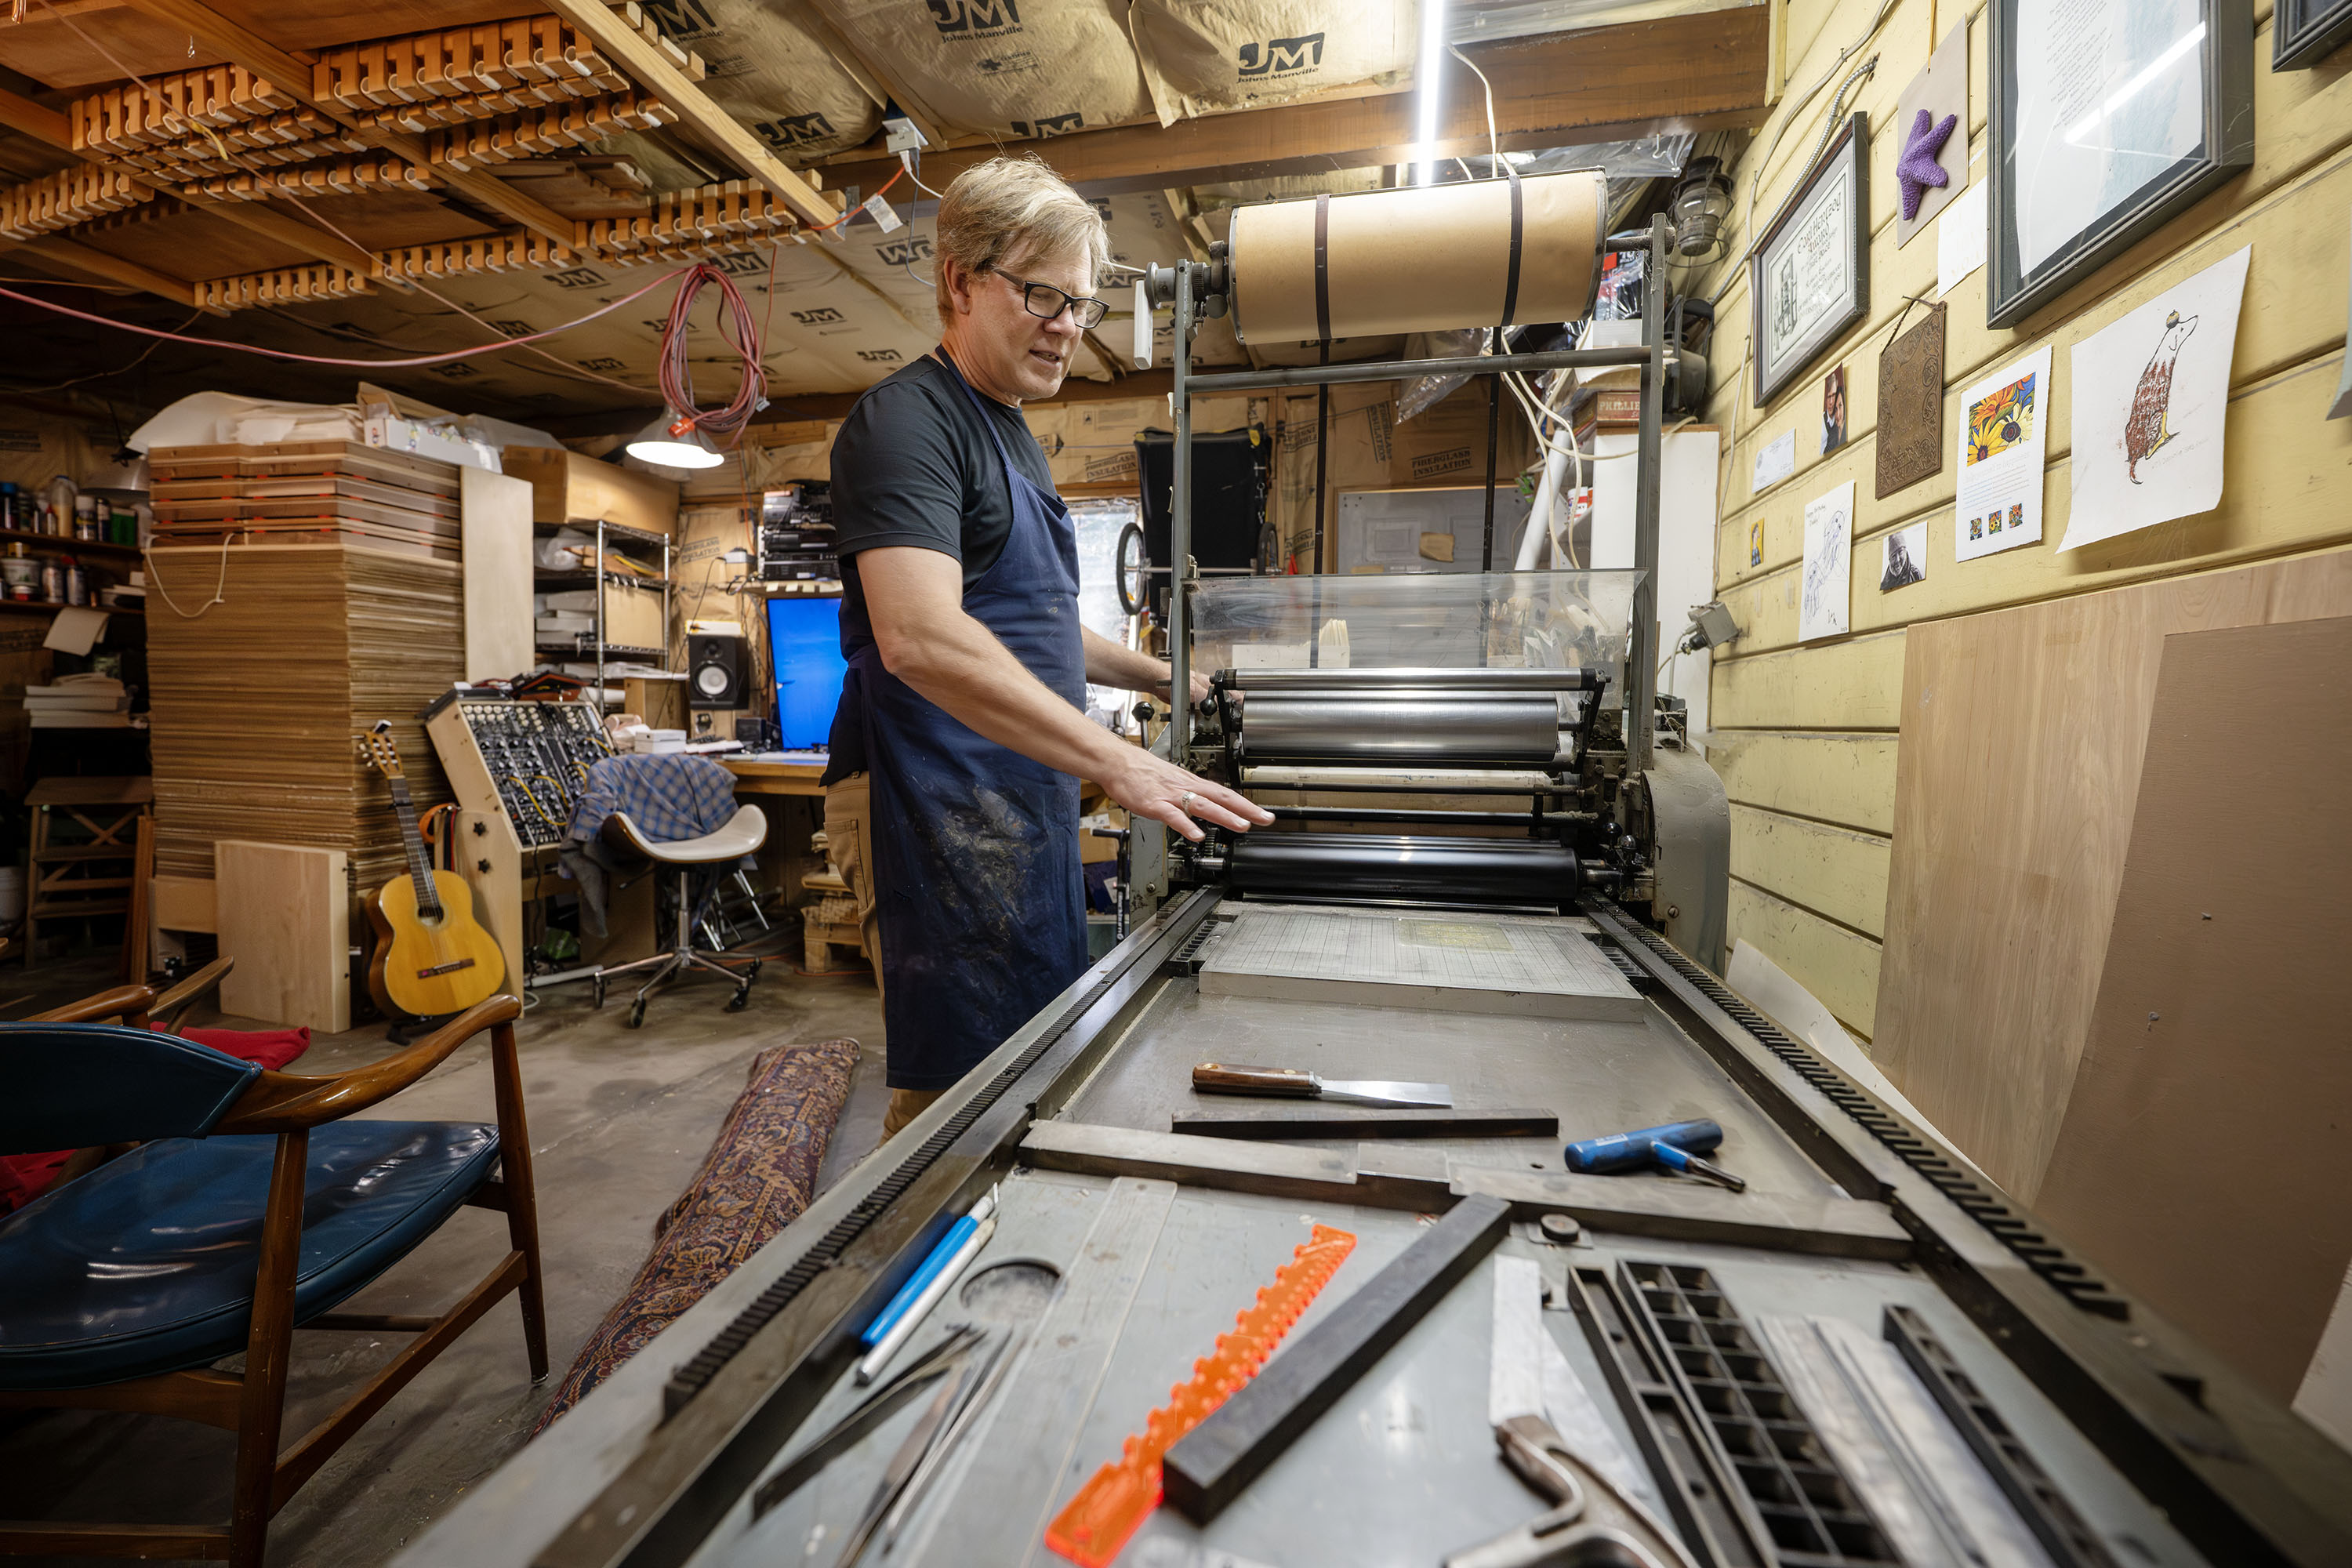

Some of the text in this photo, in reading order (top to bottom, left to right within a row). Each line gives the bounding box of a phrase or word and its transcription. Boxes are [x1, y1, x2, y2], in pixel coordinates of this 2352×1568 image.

[926, 0, 1021, 32] JM
[942, 26, 1024, 44] Johns Manville
[1239, 32, 1325, 76] JM
[1236, 67, 1319, 84] Johns Manville
[754, 112, 837, 147] JM
[709, 252, 769, 274] JM
[543, 267, 607, 288] JM
[790, 307, 844, 324] JM
[857, 349, 903, 361] JM
[1599, 401, 1640, 412] PHILLIE
[1412, 449, 1471, 469] FIBERGLASS
[1414, 458, 1472, 477] INSULATION
